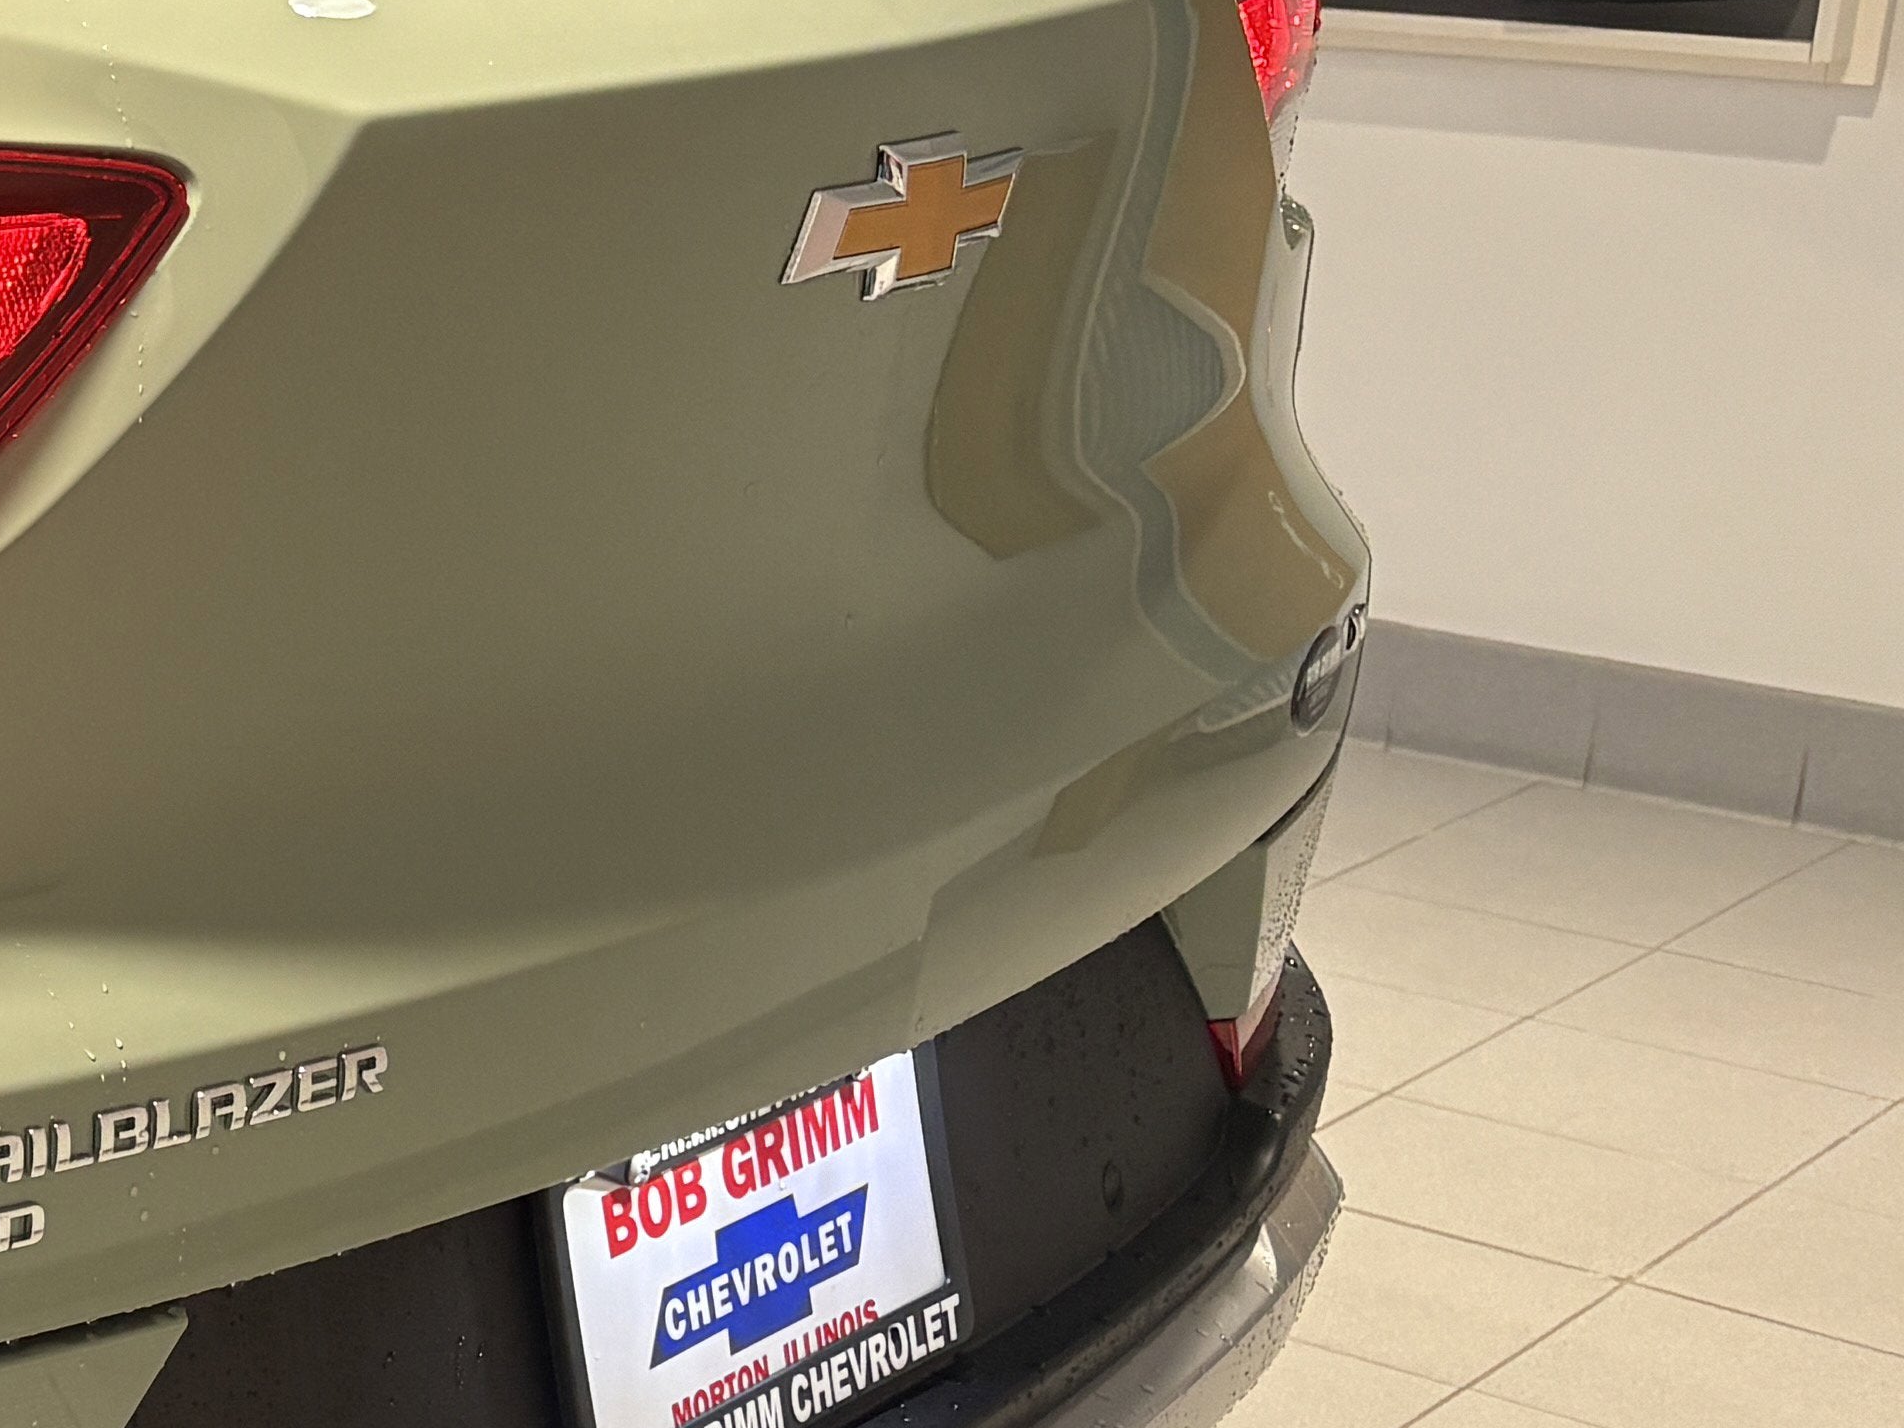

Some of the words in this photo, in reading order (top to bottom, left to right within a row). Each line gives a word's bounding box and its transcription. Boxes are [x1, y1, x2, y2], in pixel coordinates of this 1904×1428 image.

[601, 1157, 708, 1259] BOB
[721, 1072, 880, 1200] GRIMM
[664, 1210, 853, 1341] CHEVROLET
[782, 1299, 880, 1371] ILLINOIS
[791, 1293, 961, 1424] CHEVROLET
